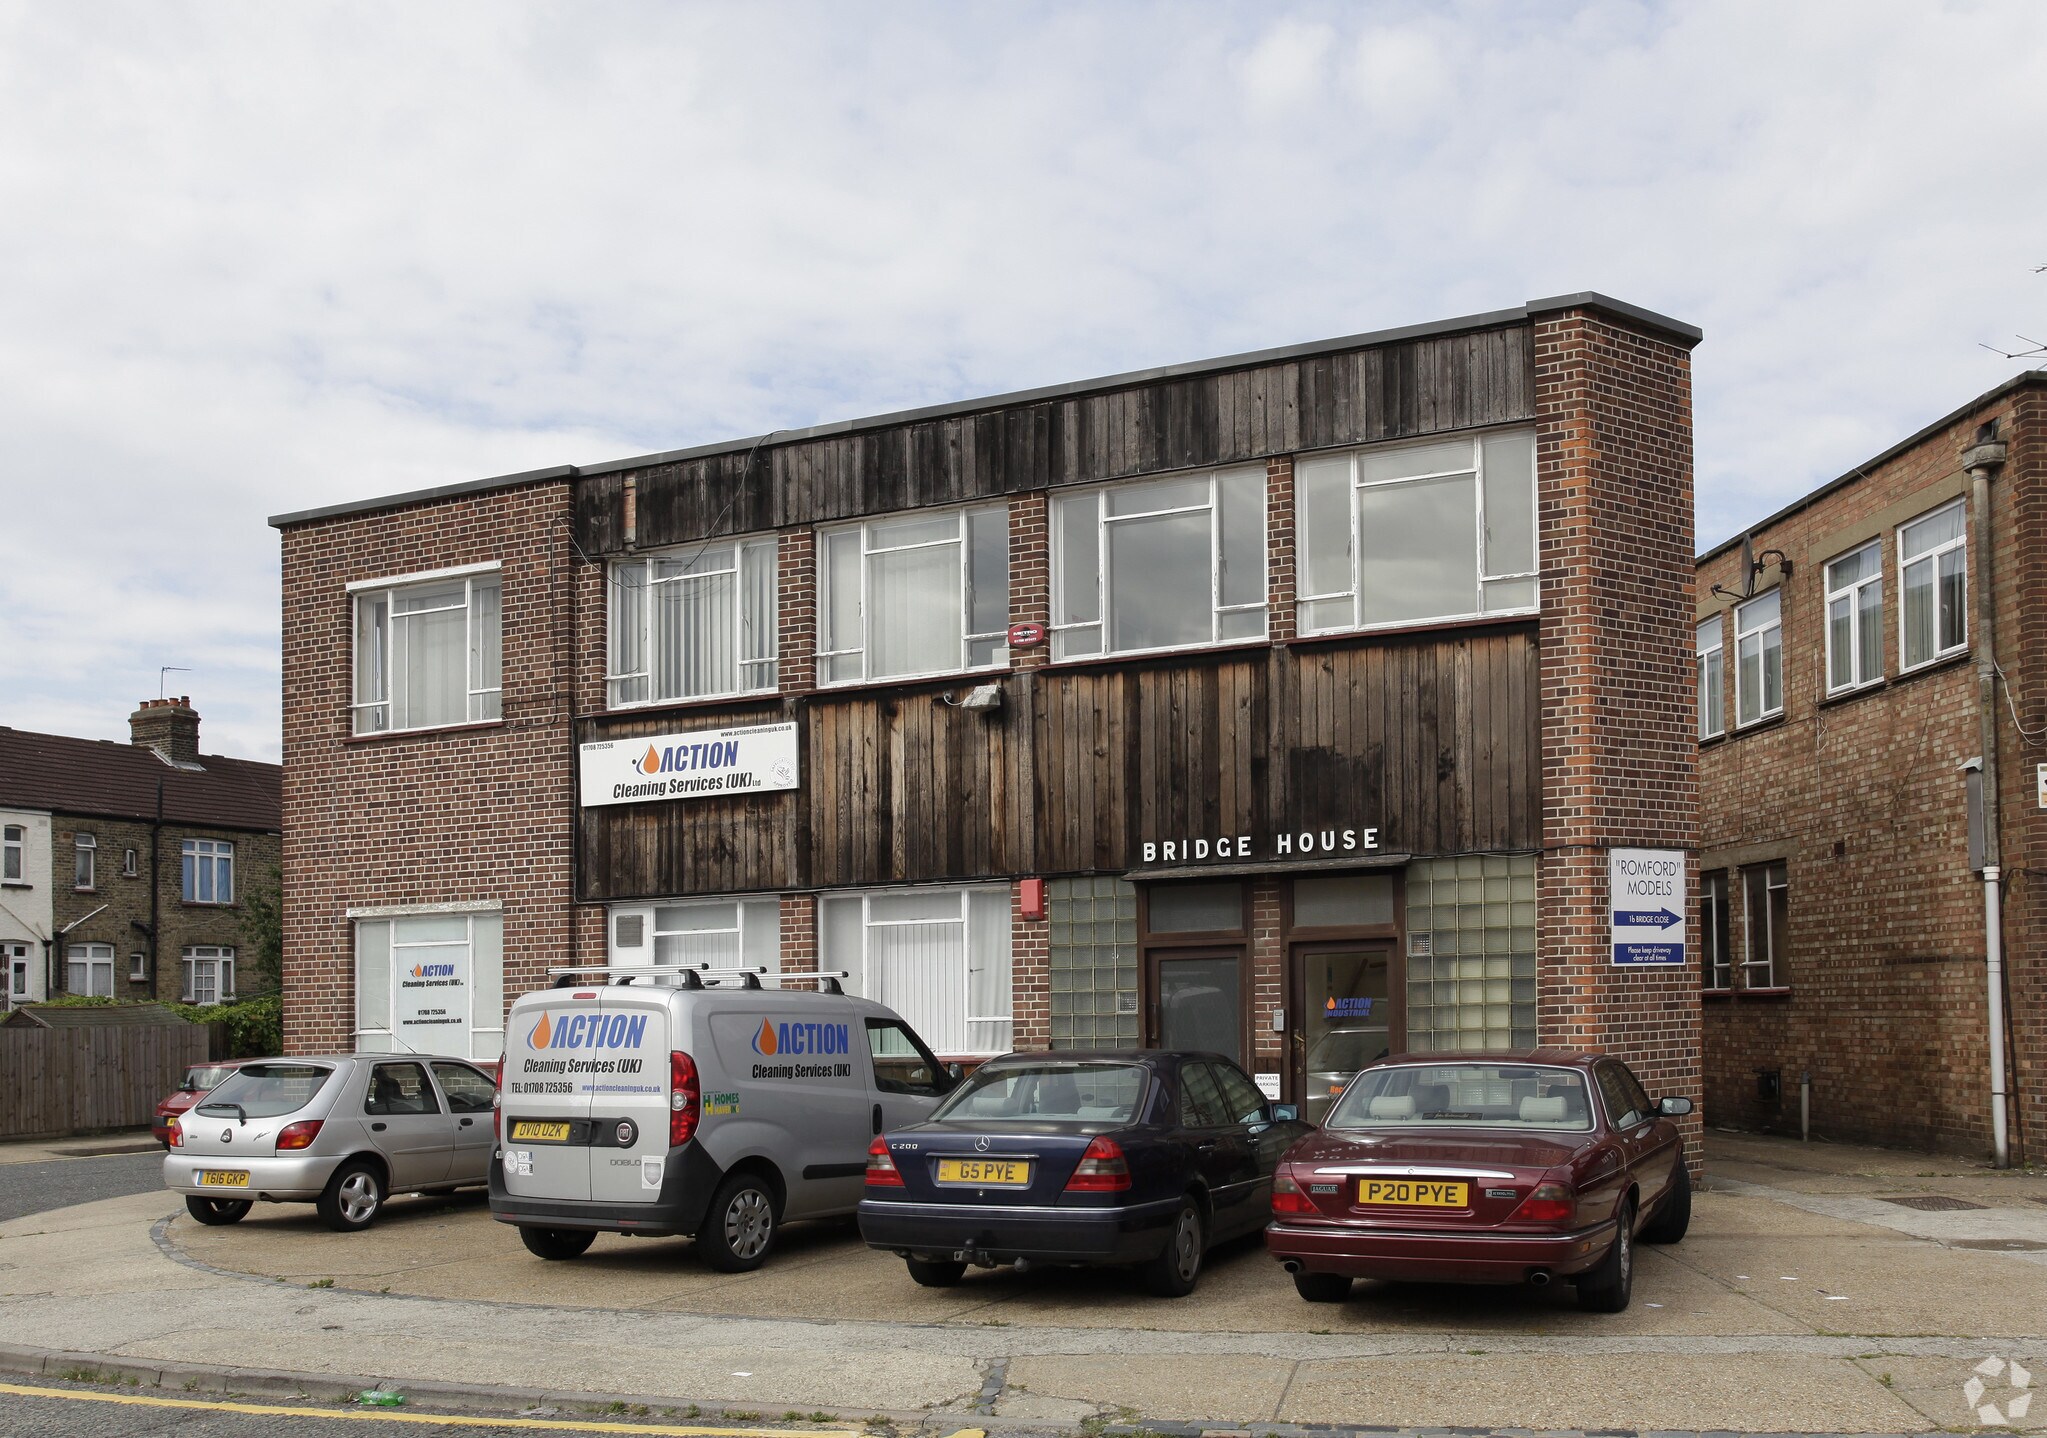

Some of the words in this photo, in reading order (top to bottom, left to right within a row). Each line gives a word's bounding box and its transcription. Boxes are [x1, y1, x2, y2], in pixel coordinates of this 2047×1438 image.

[721, 725, 792, 738] www.actioncleaninguk.co.uk
[659, 741, 739, 773] ACTION
[613, 780, 667, 799] Cleaning
[669, 775, 723, 793] Services
[726, 772, 752, 788] (UK)
[1143, 836, 1251, 862] BRIDGE
[1277, 828, 1378, 854] HOUSE
[1616, 860, 1681, 876] "ROMFORD"
[1627, 880, 1672, 896] MODELS
[1629, 915, 1635, 923] 1b
[1627, 946, 1641, 954] Please
[1641, 946, 1652, 955] keep
[1653, 946, 1671, 955] driveway
[422, 964, 454, 977] ACTION
[402, 980, 425, 988] Cleaning
[426, 979, 448, 987] Services
[1335, 997, 1372, 1009] ACTION
[550, 1014, 648, 1049] ACTION
[777, 1022, 848, 1055] ACTION
[524, 1058, 565, 1074] Cleaning
[567, 1058, 615, 1073] Services
[617, 1058, 643, 1073] (UK)
[752, 1064, 793, 1079] Cleaning
[795, 1063, 832, 1078] Services
[834, 1063, 851, 1077] (UK)
[511, 1082, 523, 1093] TEL:
[524, 1082, 544, 1093] 01708
[545, 1082, 573, 1093] 725356
[582, 1084, 661, 1094] www.actioncleaninguk.co.uk
[715, 1093, 739, 1104] HOMES
[543, 1124, 564, 1137] UZK
[205, 1172, 225, 1184] T616
[226, 1173, 246, 1185] GKP
[960, 1163, 979, 1179] G5
[984, 1163, 1016, 1180] PYE
[1368, 1183, 1410, 1202] P20
[1415, 1185, 1458, 1203] PYE
